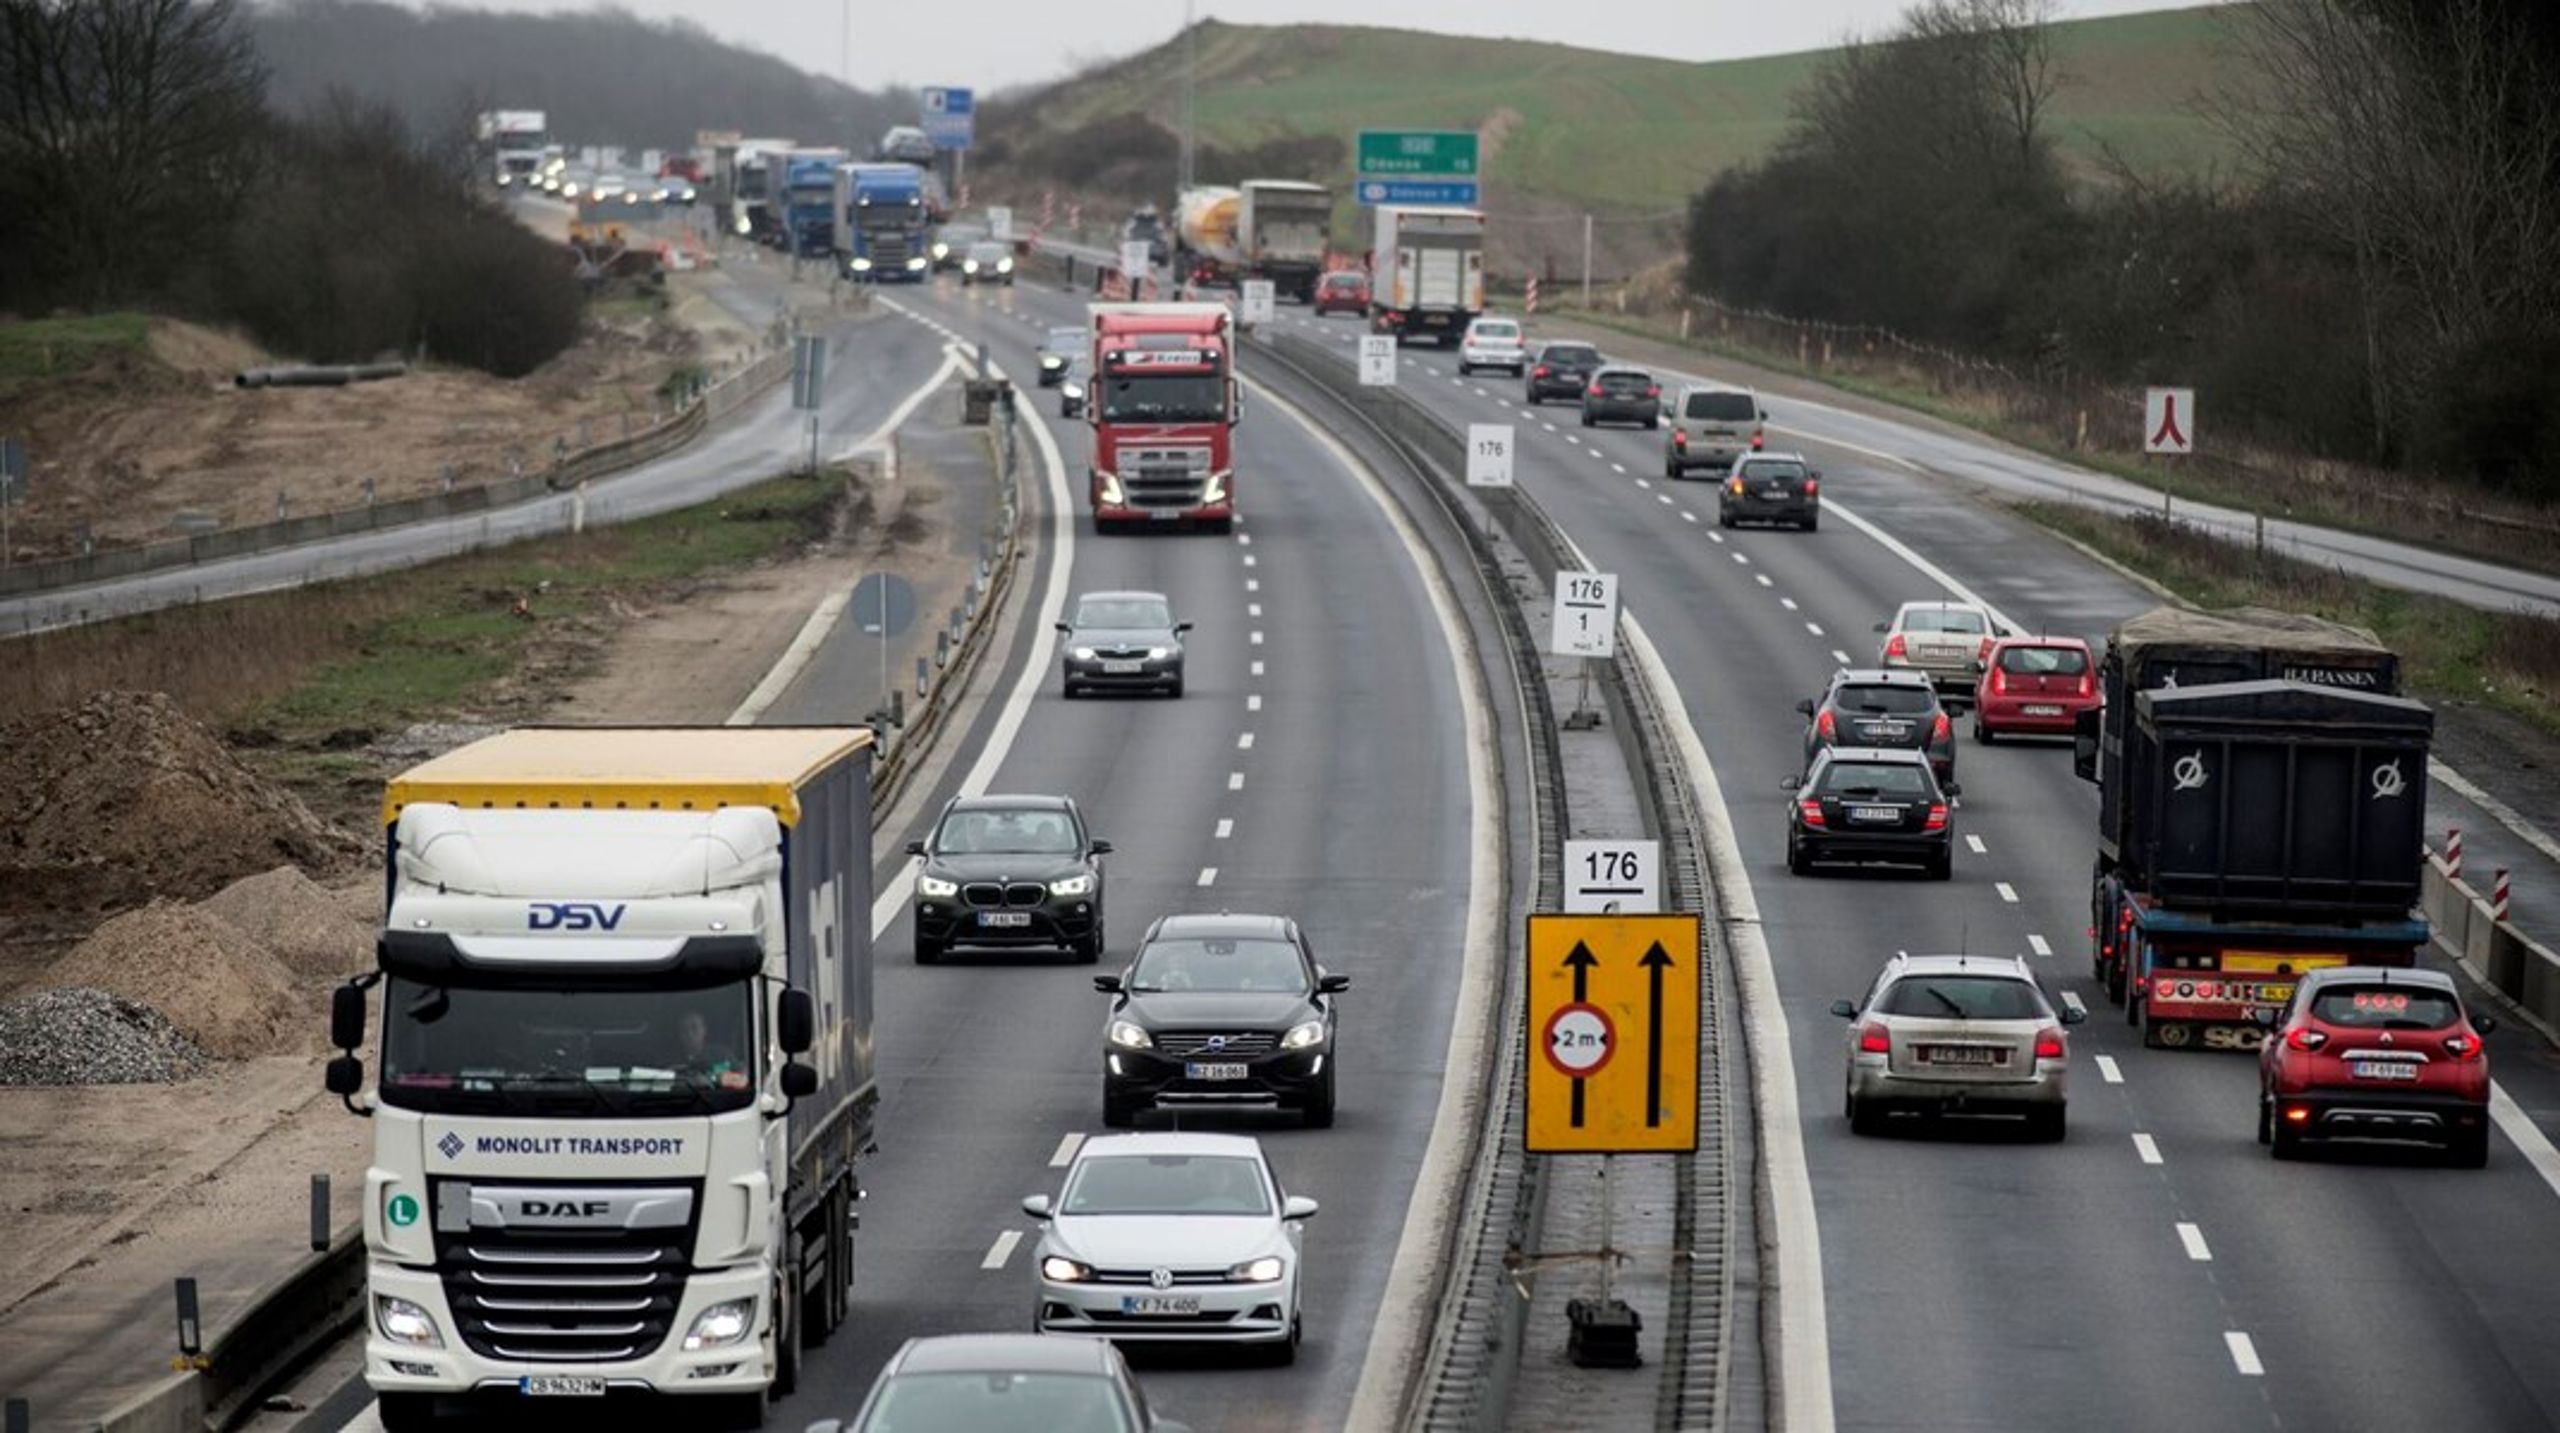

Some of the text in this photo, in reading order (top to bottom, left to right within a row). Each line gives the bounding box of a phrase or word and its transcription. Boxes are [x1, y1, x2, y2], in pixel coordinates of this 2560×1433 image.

[1479, 441, 1503, 457] 176
[1570, 580, 1604, 599] 176
[1580, 613, 1588, 630] 1
[1586, 851, 1638, 881] 176
[528, 904, 625, 930] DSV
[1562, 1030, 1596, 1047] 2 m
[477, 1138, 683, 1154] MONOLIT TRANSPORT
[395, 1200, 410, 1222] L
[520, 1201, 610, 1217] DAF
